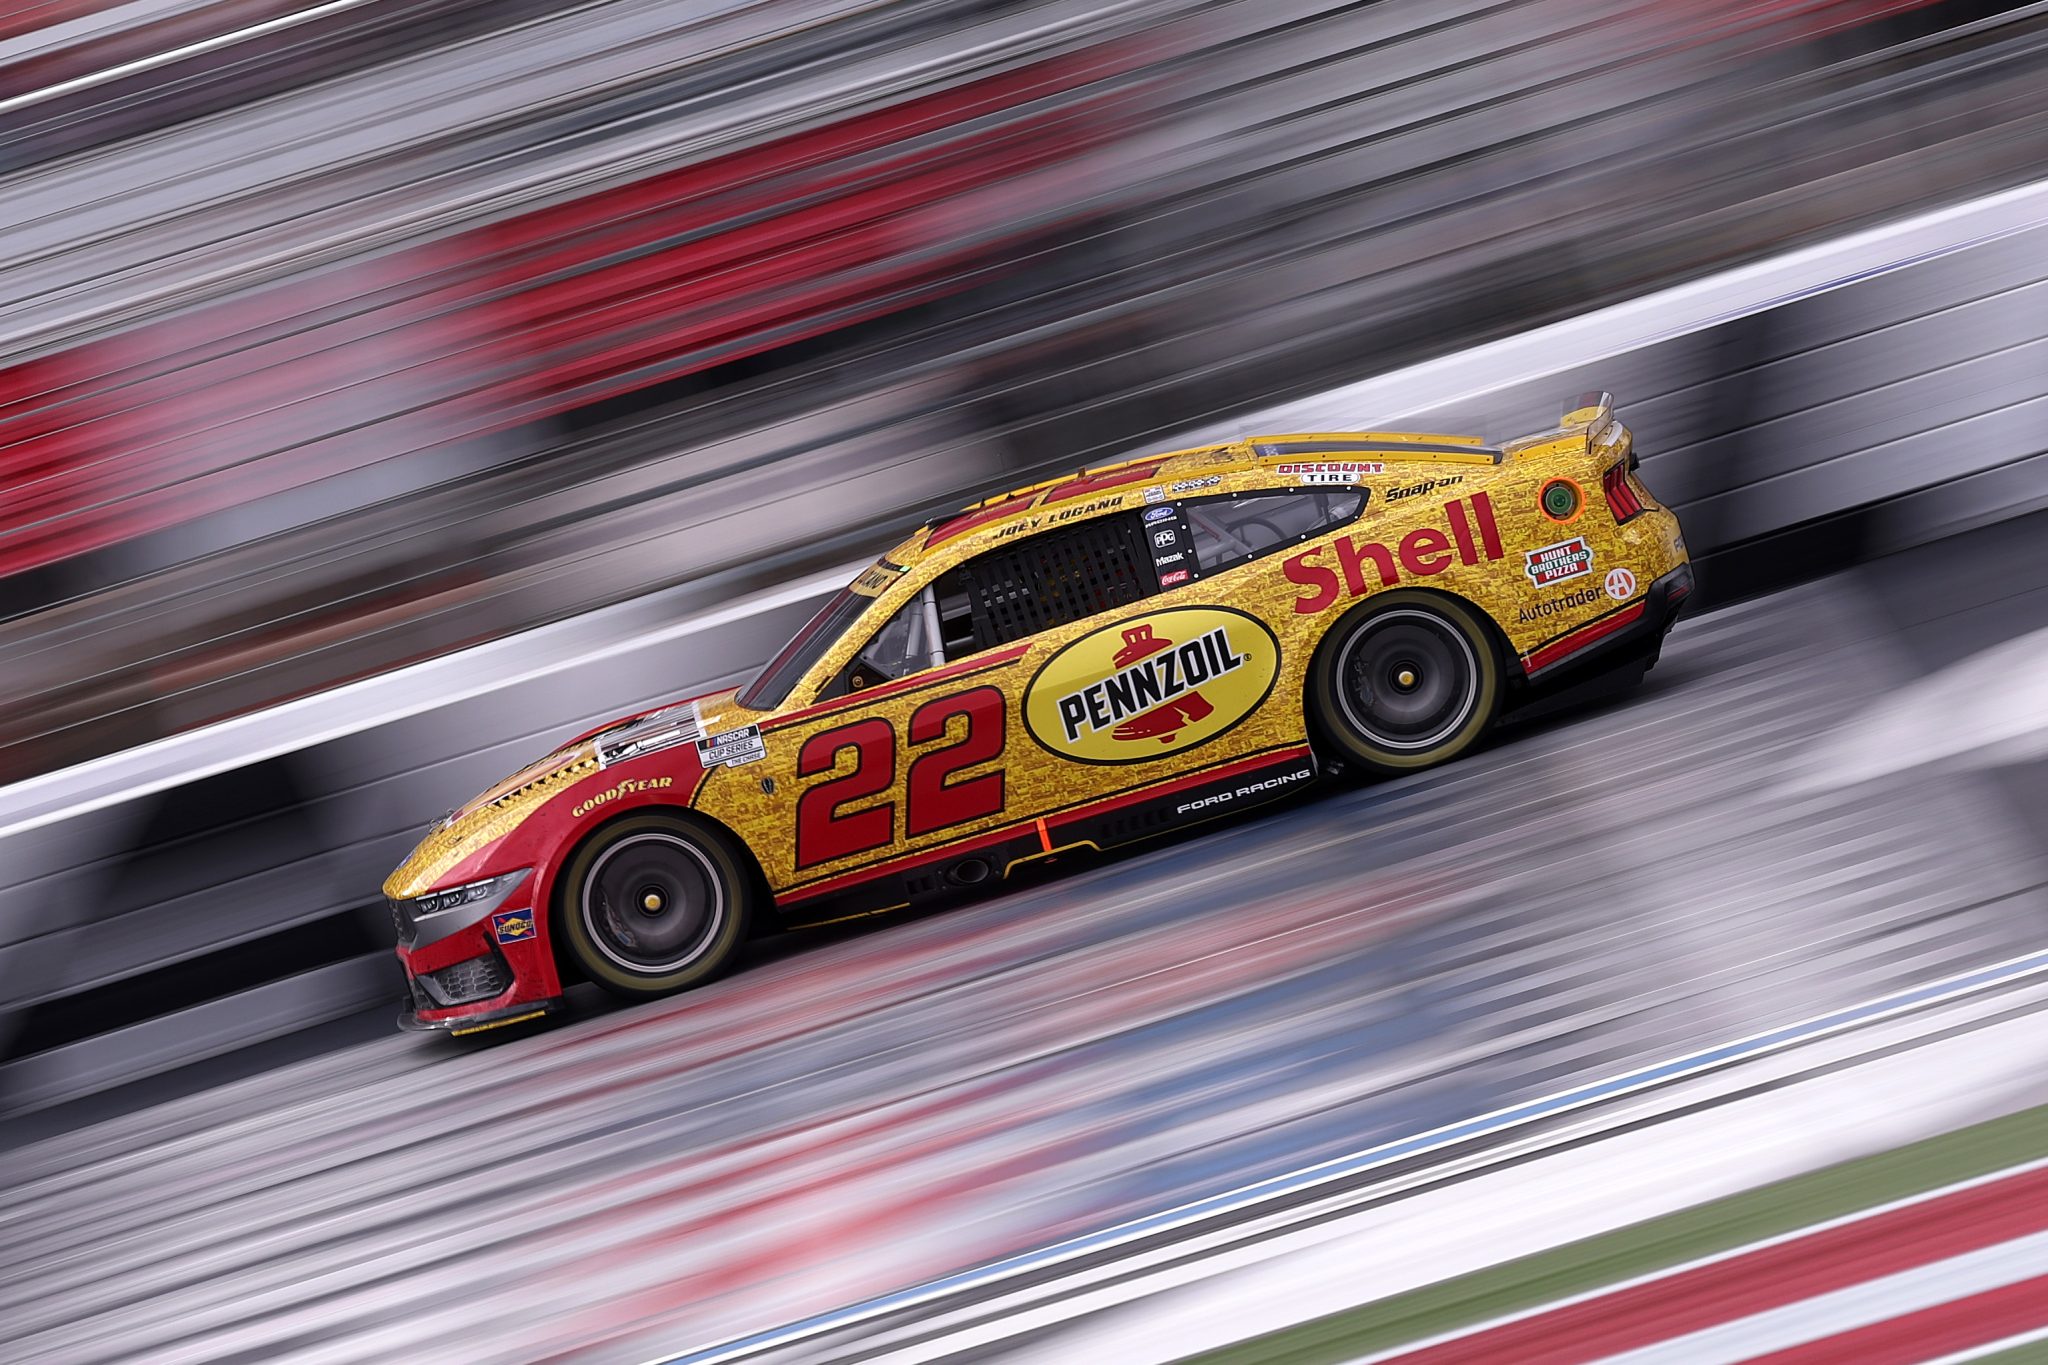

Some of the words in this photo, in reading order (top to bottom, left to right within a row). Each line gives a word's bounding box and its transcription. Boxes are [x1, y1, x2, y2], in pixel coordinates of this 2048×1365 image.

[1278, 463, 1384, 474] DISCOUNT
[1306, 474, 1353, 482] TIRE
[1385, 475, 1464, 503] Snap-on
[992, 517, 1042, 540] JOEY
[1048, 495, 1124, 524] LOGANO
[1148, 508, 1170, 520] Ford
[1156, 532, 1175, 546] PPG
[1155, 552, 1185, 567] Mazak
[1282, 490, 1505, 615] Shell
[1530, 550, 1589, 575] BROTHERS
[1540, 545, 1573, 563] HUNT
[1545, 562, 1579, 580] PIZZA
[1519, 586, 1602, 624] Autotrader
[1057, 625, 1244, 744] PENNZOIL
[716, 728, 750, 746] NASCAR
[708, 747, 726, 760] CUP
[726, 740, 754, 755] SERIES
[795, 684, 1007, 872] 22
[571, 777, 673, 818] GOODYEAR
[1176, 792, 1233, 814] FORD
[1235, 769, 1311, 797] RACING
[497, 920, 533, 934] SUNOCO
